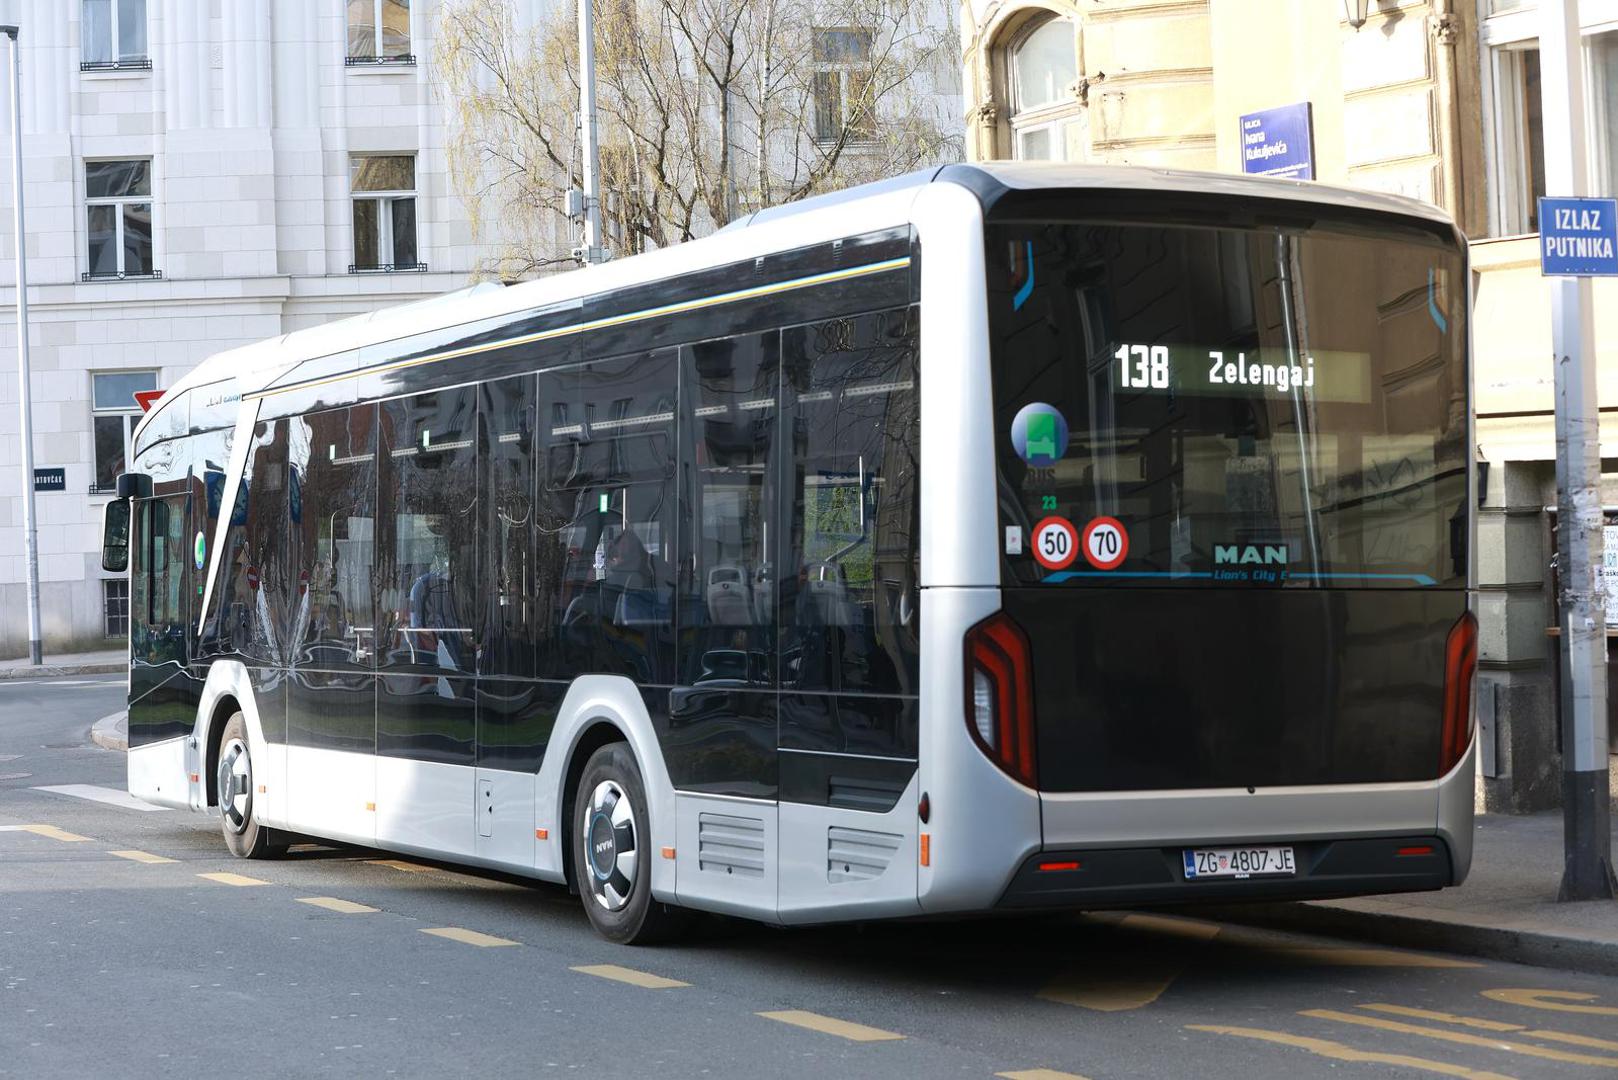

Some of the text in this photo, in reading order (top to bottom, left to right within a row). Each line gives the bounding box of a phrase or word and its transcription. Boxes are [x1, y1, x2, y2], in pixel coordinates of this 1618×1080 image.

[1555, 208, 1601, 231] IZLAZ
[1545, 236, 1614, 258] PUTNIKA
[1114, 344, 1315, 392] 138 Zelengaj
[1042, 496, 1057, 510] 23
[1045, 531, 1067, 555] 50
[1094, 531, 1117, 556] 70
[1215, 545, 1287, 564] MAN
[1214, 569, 1249, 580] Lion's
[1252, 569, 1277, 583] City
[596, 839, 613, 853] MAN
[1196, 852, 1218, 873] ZG
